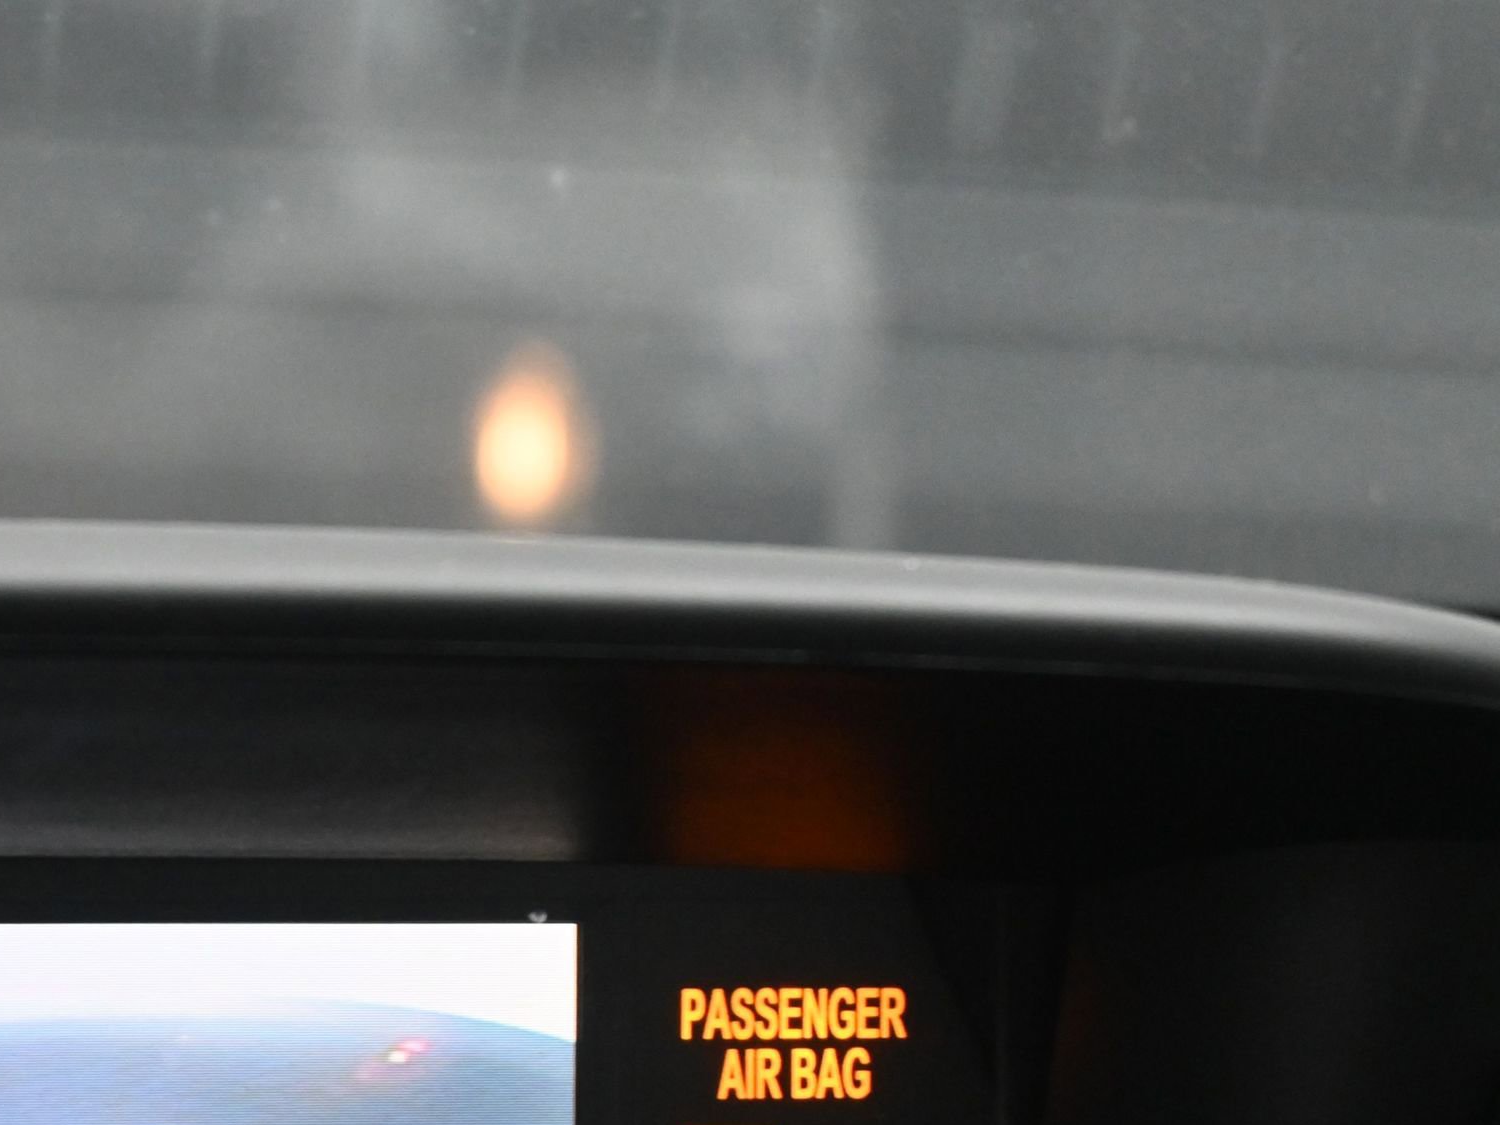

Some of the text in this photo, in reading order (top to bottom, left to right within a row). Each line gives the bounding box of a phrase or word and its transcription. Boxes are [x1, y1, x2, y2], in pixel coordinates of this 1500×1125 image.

[679, 986, 908, 1041] PASSENGER
[716, 1046, 873, 1101] AIR BAG
